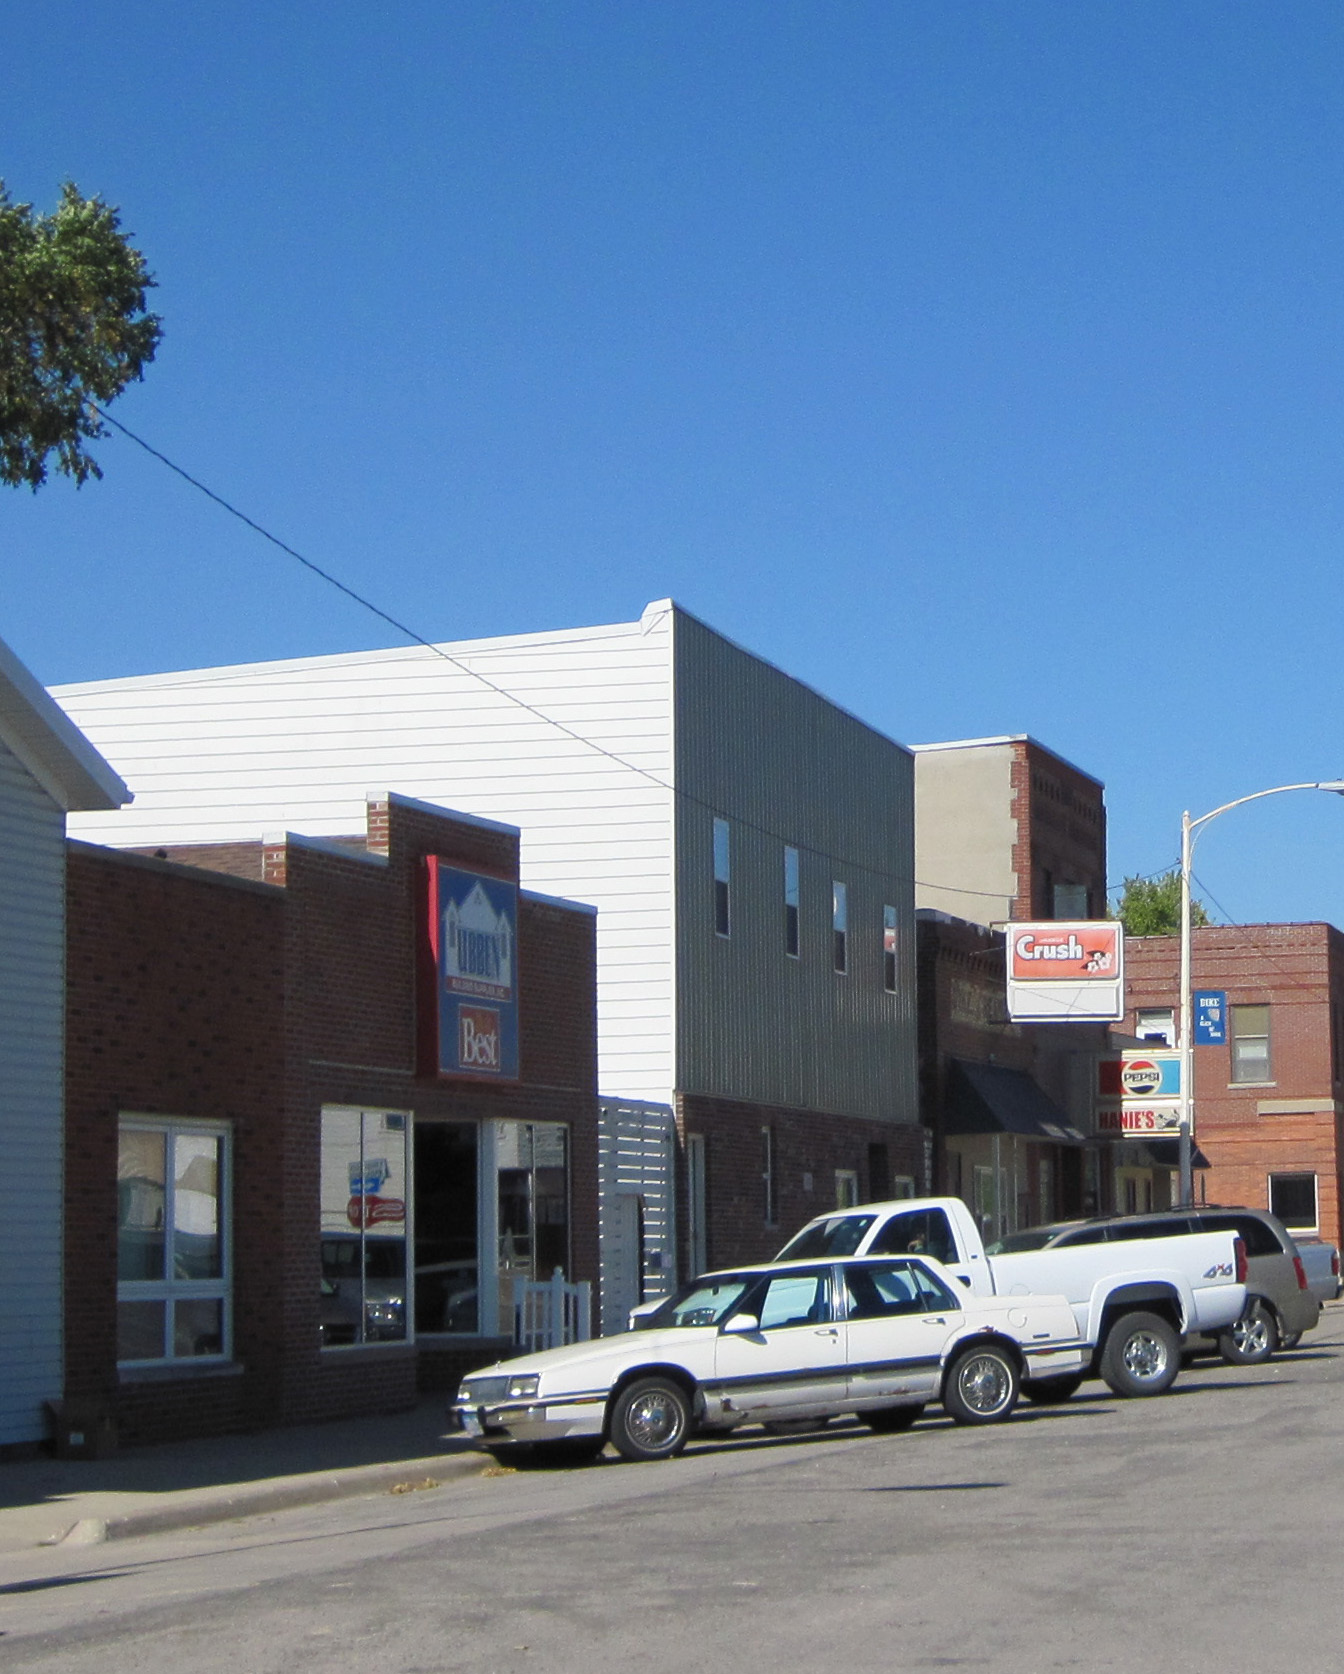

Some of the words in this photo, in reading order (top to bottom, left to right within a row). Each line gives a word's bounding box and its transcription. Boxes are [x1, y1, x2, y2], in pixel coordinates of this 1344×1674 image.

[1016, 934, 1084, 960] Crush
[1200, 998, 1220, 1007] DIKE
[462, 1018, 498, 1065] Best
[1124, 1072, 1159, 1082] PEPSI
